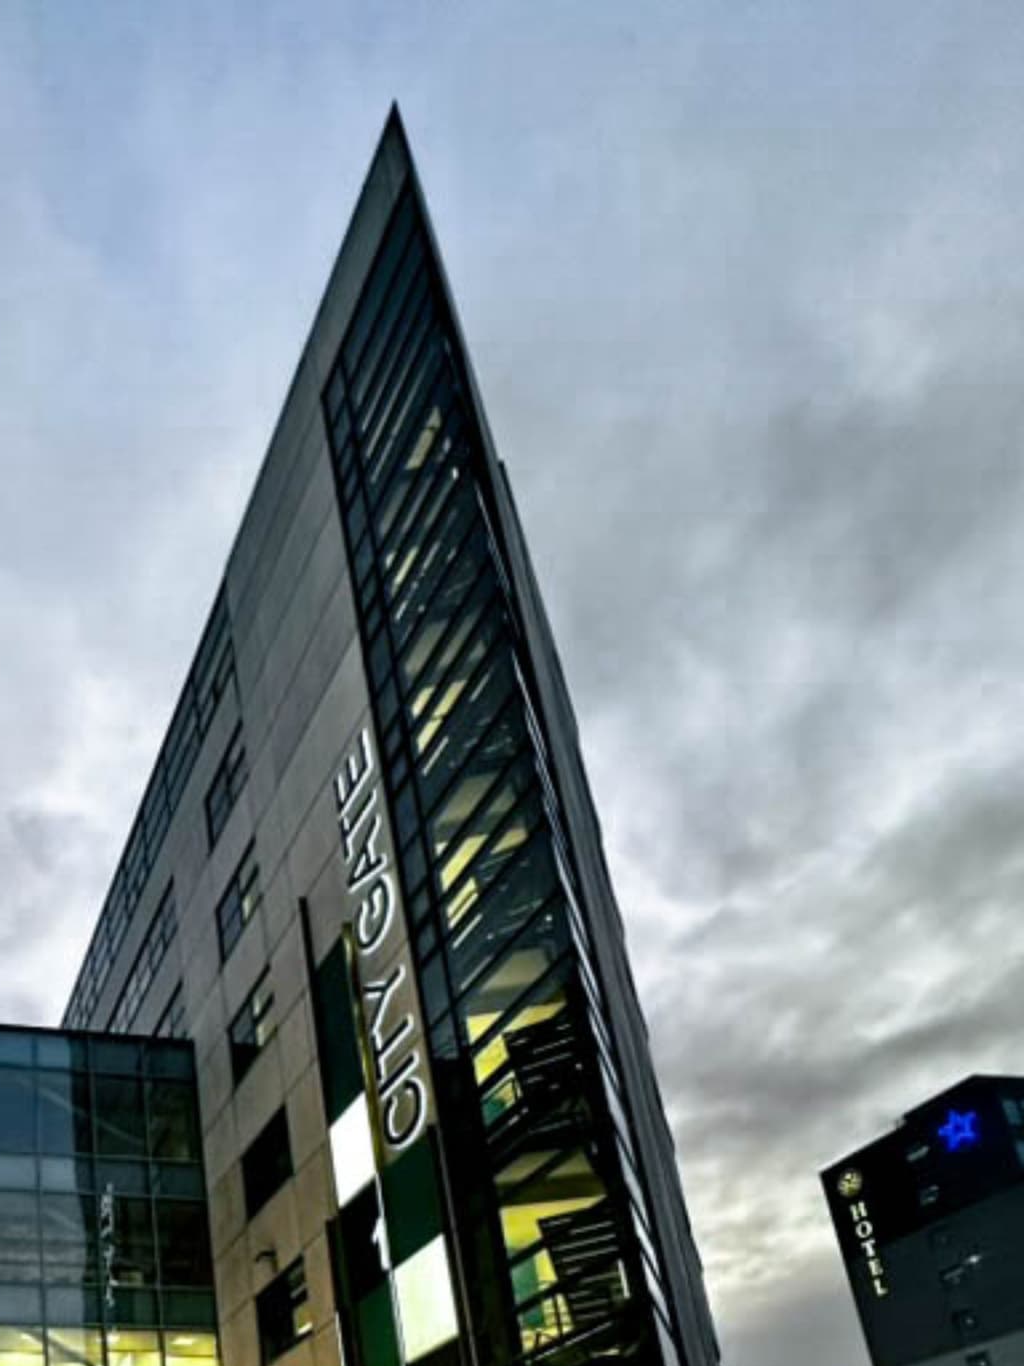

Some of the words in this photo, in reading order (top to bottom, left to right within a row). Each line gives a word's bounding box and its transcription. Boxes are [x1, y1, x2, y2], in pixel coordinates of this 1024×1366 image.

[333, 728, 395, 956] GATE
[362, 963, 427, 1151] CITY
[849, 1201, 887, 1296] HOTEL
